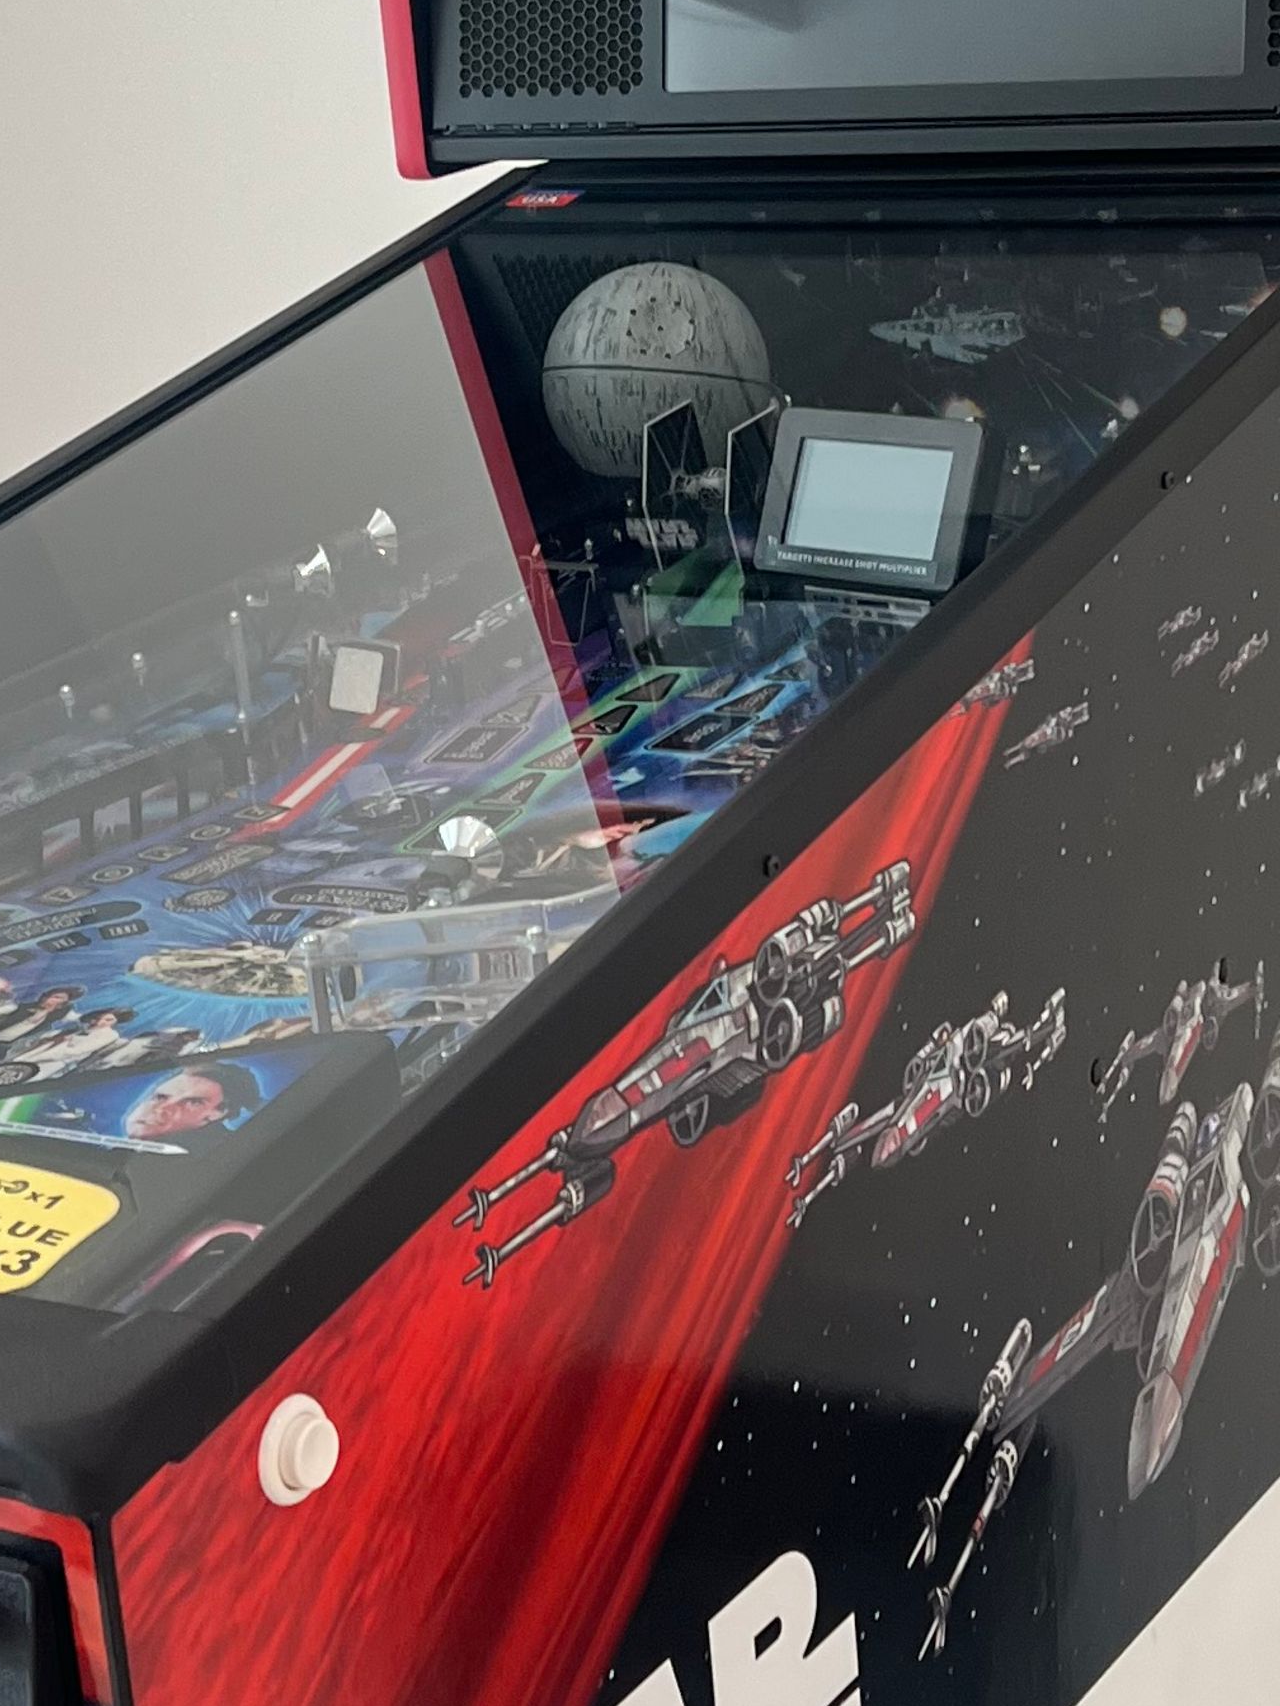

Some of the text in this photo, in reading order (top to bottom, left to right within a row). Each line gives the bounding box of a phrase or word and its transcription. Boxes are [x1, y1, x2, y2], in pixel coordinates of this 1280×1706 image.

[777, 551, 927, 576] TARGETS INCREASE SHOT MULTIPLIER
[24, 1189, 65, 1210] x1
